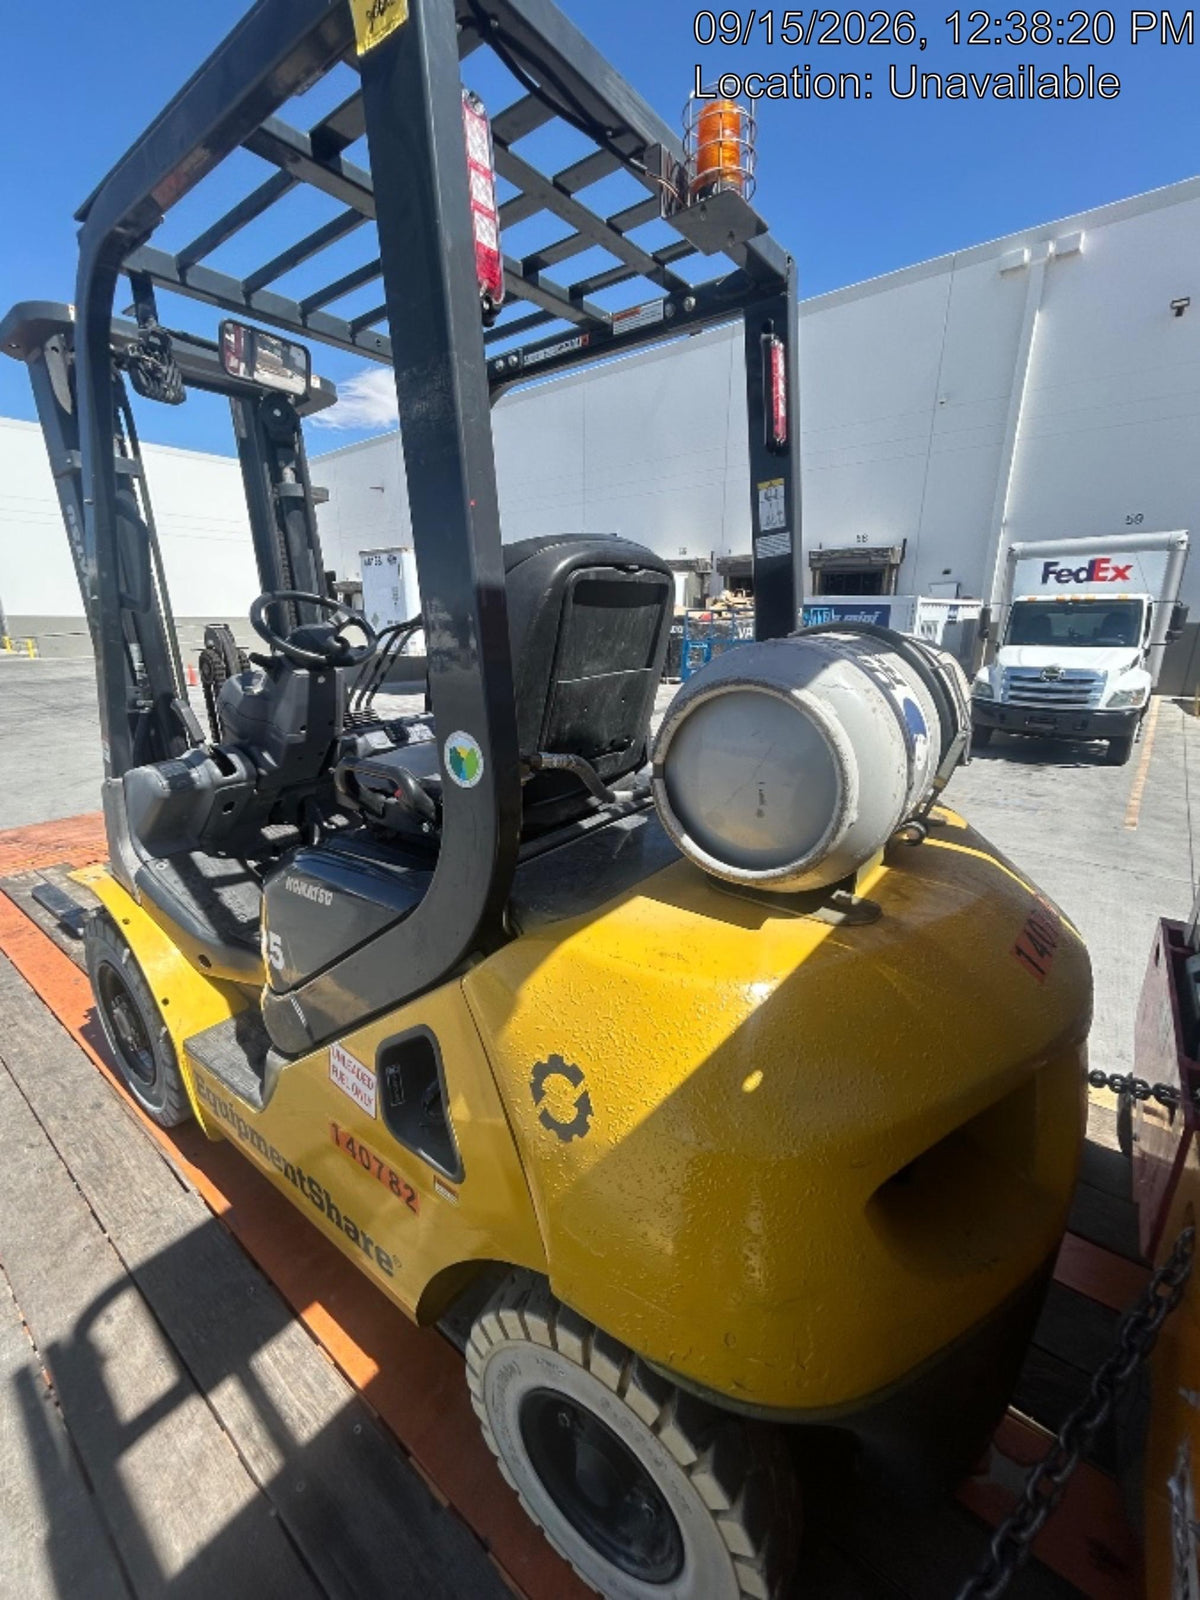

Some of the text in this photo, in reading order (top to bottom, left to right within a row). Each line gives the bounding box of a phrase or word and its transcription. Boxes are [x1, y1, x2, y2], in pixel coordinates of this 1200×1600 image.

[1041, 557, 1133, 585] FedEx
[285, 876, 333, 906] KOMATSU
[331, 1049, 374, 1091] UNLEADED
[331, 1064, 352, 1092] FUEL
[350, 1082, 374, 1107] ONLY
[194, 1072, 395, 1278] EquipmentShare
[331, 1122, 418, 1214] 140782
